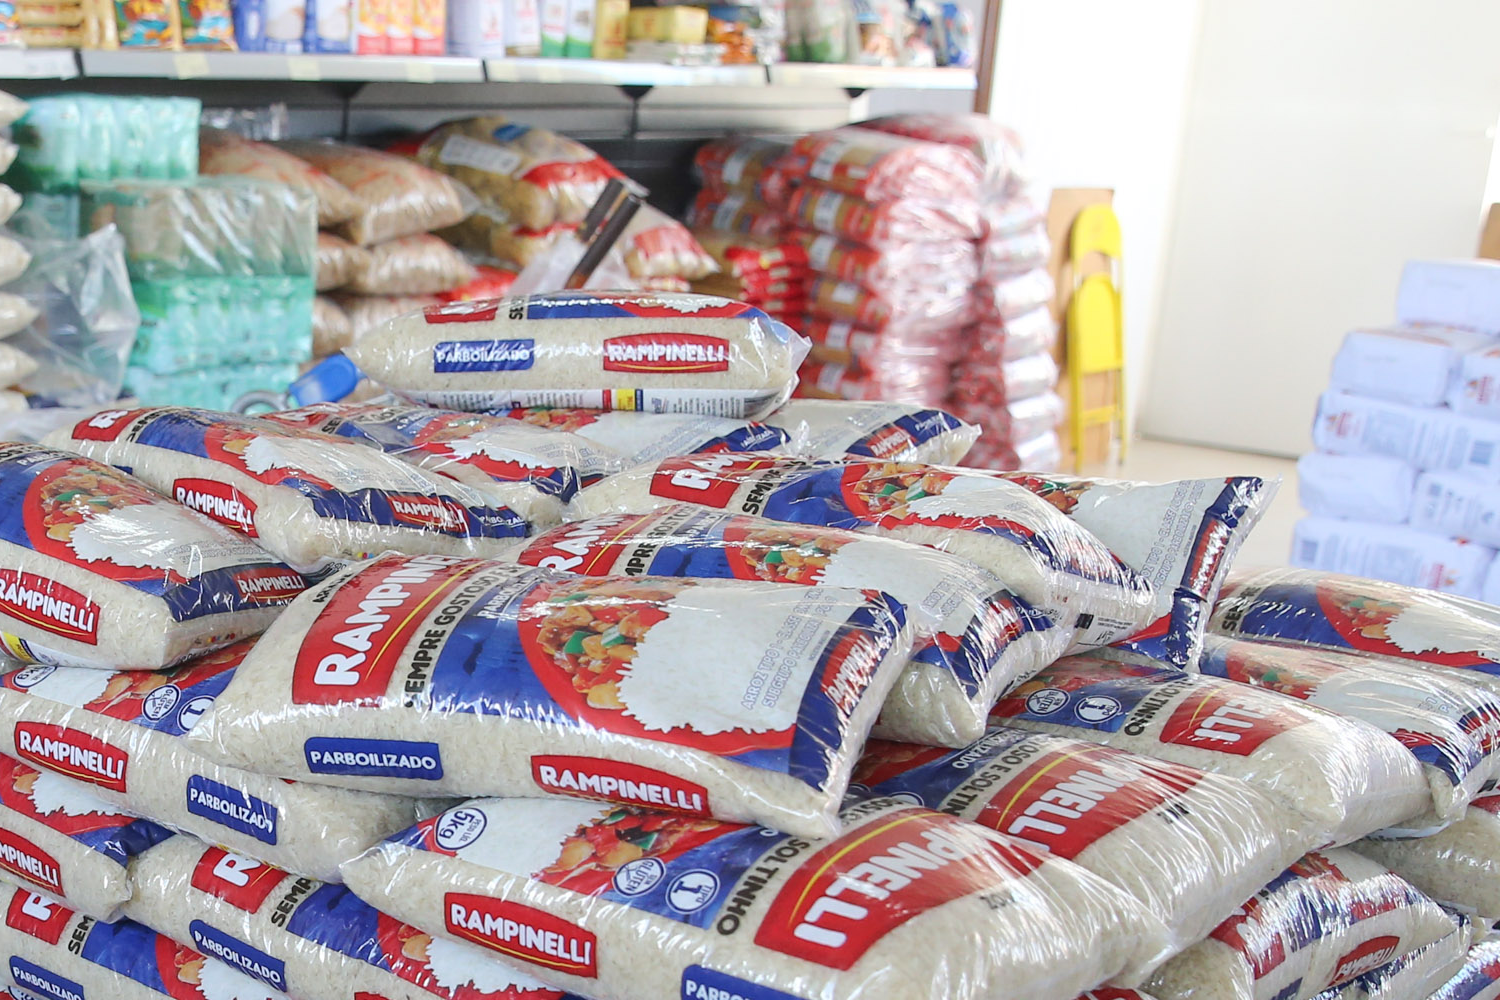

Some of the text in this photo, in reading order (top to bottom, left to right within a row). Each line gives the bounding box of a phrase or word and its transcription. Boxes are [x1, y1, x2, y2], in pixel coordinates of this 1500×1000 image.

[607, 343, 726, 363] RAMPINELLI
[626, 541, 651, 577] MPRE
[238, 575, 306, 596] RAMPINELLI
[20, 731, 124, 780] RAMPINELLI
[309, 750, 437, 772] PARBOILIZADO
[541, 764, 703, 812] RAMPINELLI
[439, 809, 474, 838] 5kg
[270, 877, 312, 928] SEMP
[716, 836, 811, 937] SOLTINHO
[793, 818, 960, 949] PINELLI
[67, 915, 96, 956] SEM
[194, 930, 282, 985] PARBOILIZADO
[450, 903, 592, 966] RAMPINELLI
